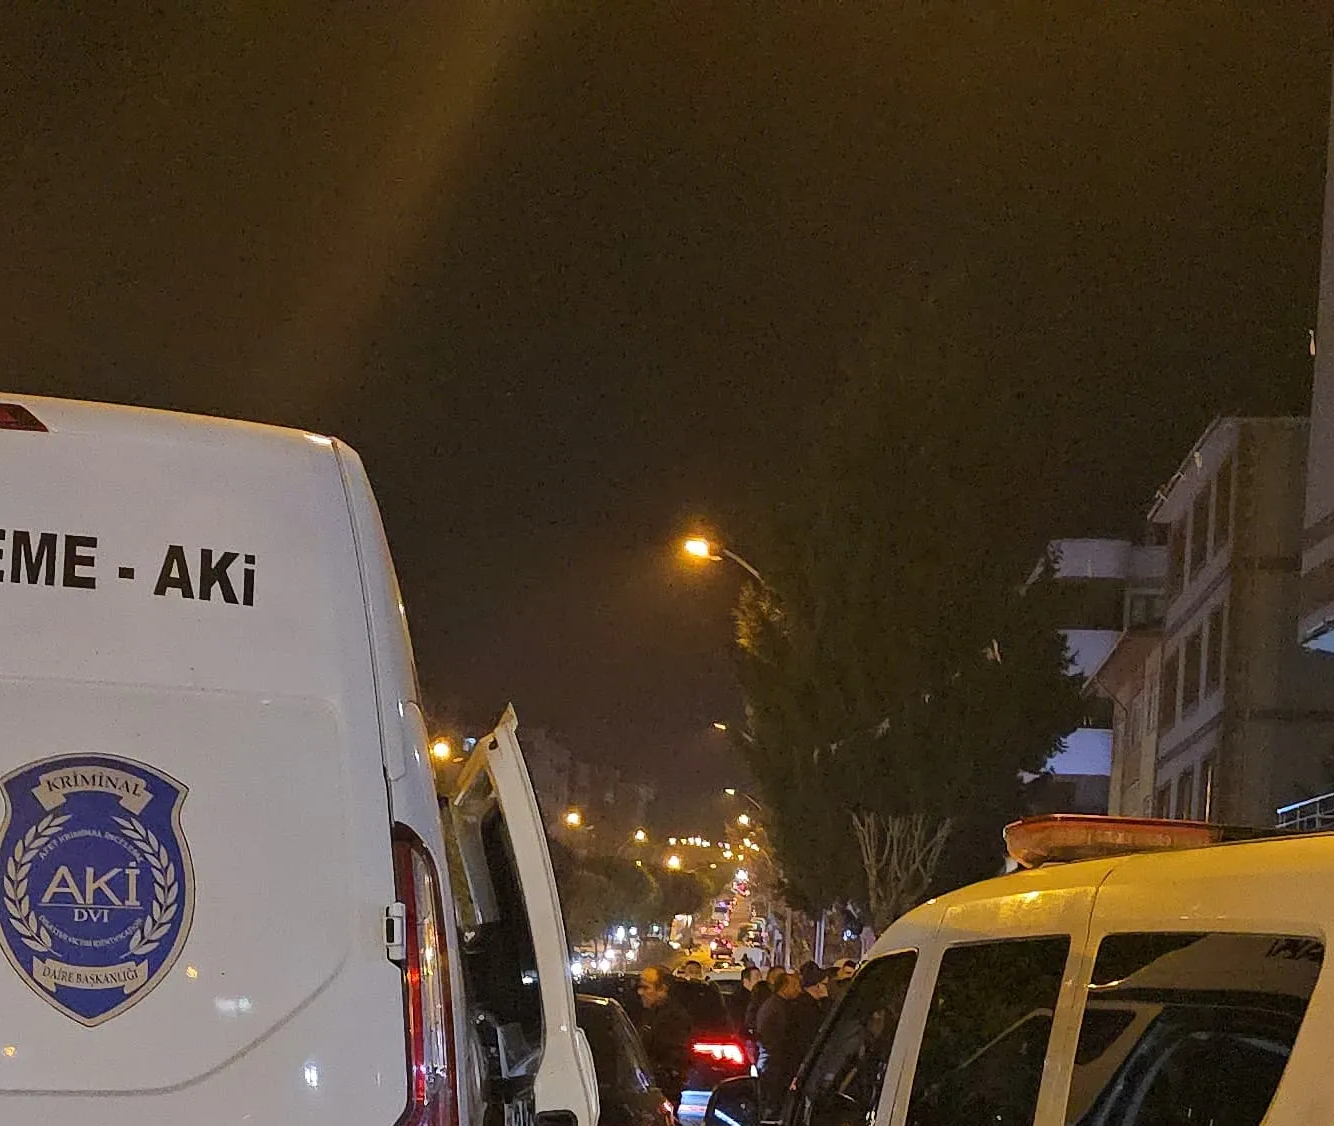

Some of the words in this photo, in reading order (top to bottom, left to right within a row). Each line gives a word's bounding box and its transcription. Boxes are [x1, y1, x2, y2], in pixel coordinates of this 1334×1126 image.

[45, 771, 143, 797] KRİMİNAL
[41, 860, 141, 907] AKİ
[73, 908, 109, 924] DVI
